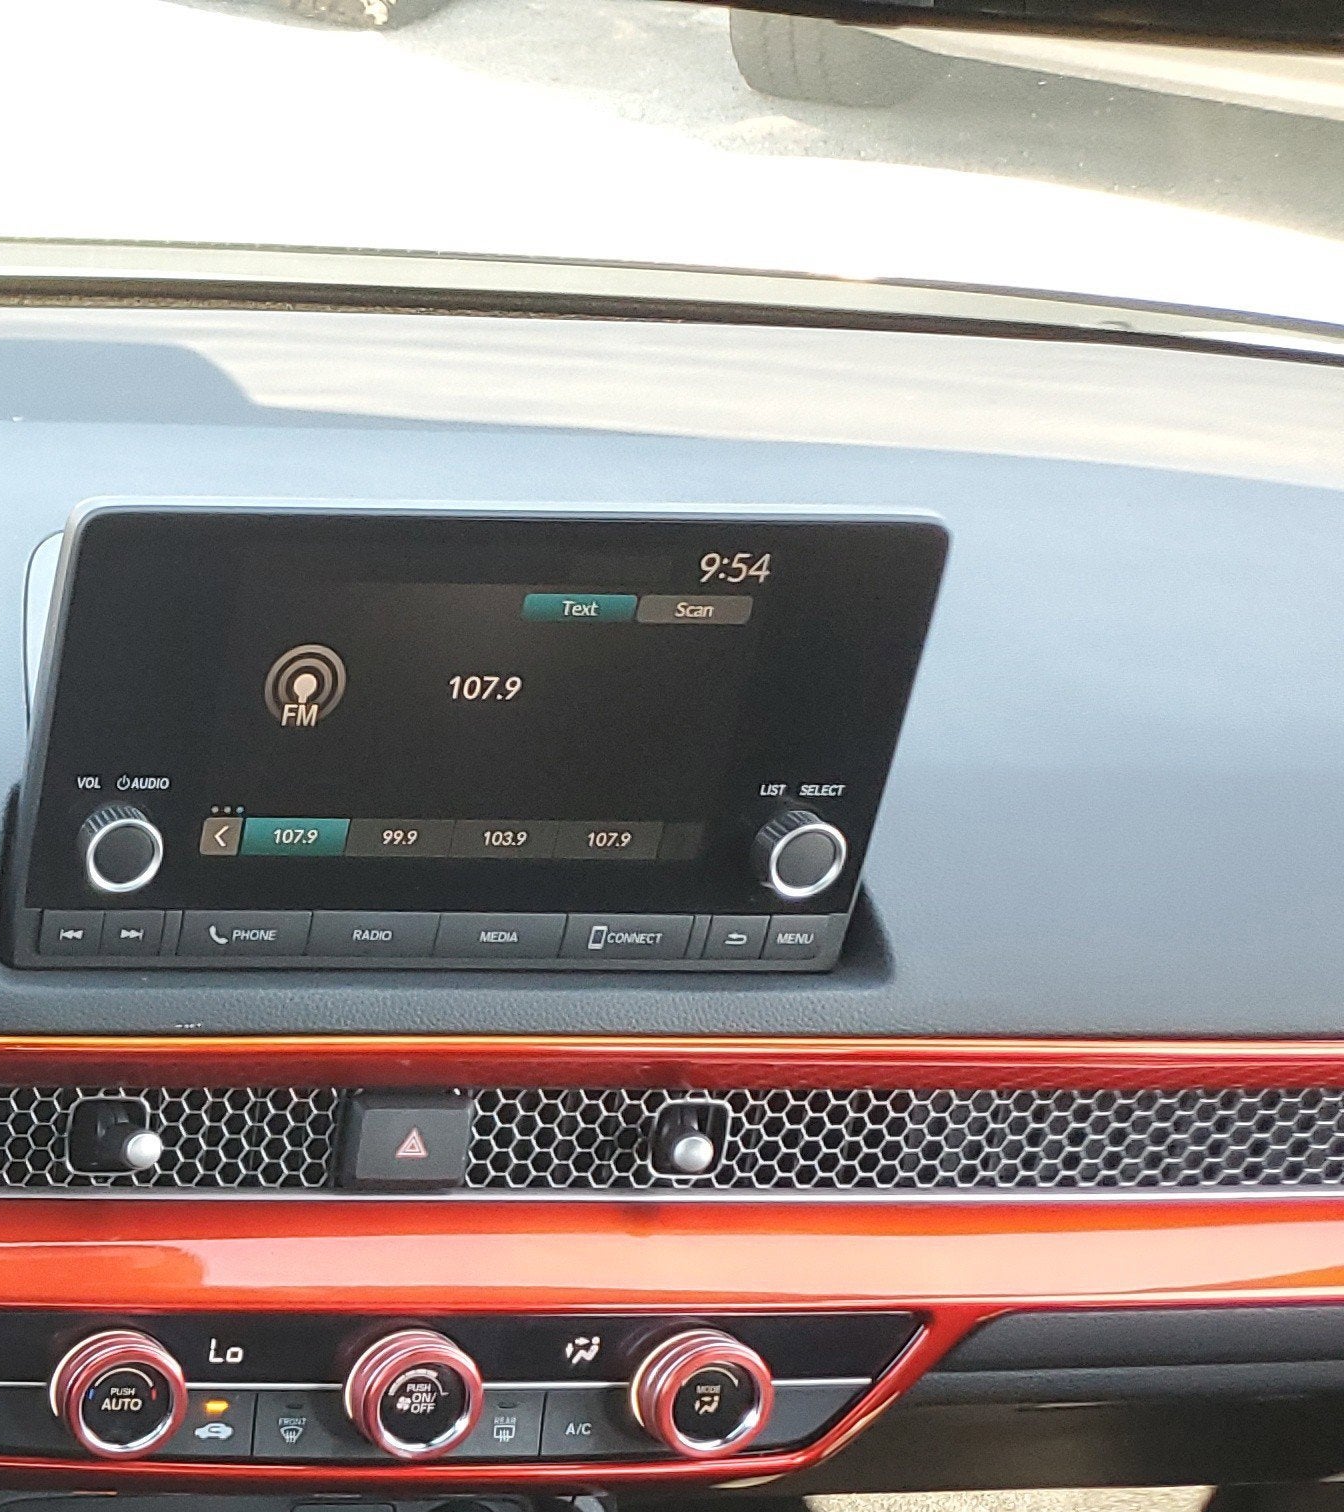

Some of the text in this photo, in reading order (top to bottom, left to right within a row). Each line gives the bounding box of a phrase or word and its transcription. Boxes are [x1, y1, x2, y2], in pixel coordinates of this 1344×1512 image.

[698, 552, 772, 584] 9:54
[561, 600, 599, 617] Text
[673, 601, 715, 618] Scan
[448, 674, 523, 701] 107.9
[280, 703, 319, 727] FM
[76, 776, 102, 791] VOL
[130, 777, 170, 791] AUDIO
[759, 784, 787, 797] LIST
[799, 784, 846, 797] SELECT
[272, 829, 319, 846] 107.9
[382, 830, 418, 846] 99.9
[482, 831, 528, 847] 103.9
[586, 832, 633, 848] 107.9
[232, 928, 277, 942] PHONE
[352, 929, 393, 942] RADIO
[479, 930, 519, 944] MEDIA
[606, 931, 664, 945] CONNECT
[776, 931, 815, 945] MENU
[208, 1338, 244, 1365] Lo
[110, 1386, 136, 1397] PUSH
[406, 1383, 432, 1393] PUSH
[100, 1398, 143, 1412] AUTO
[411, 1393, 437, 1404] ON/
[410, 1403, 436, 1414] OFF
[565, 1422, 593, 1436] A/C
